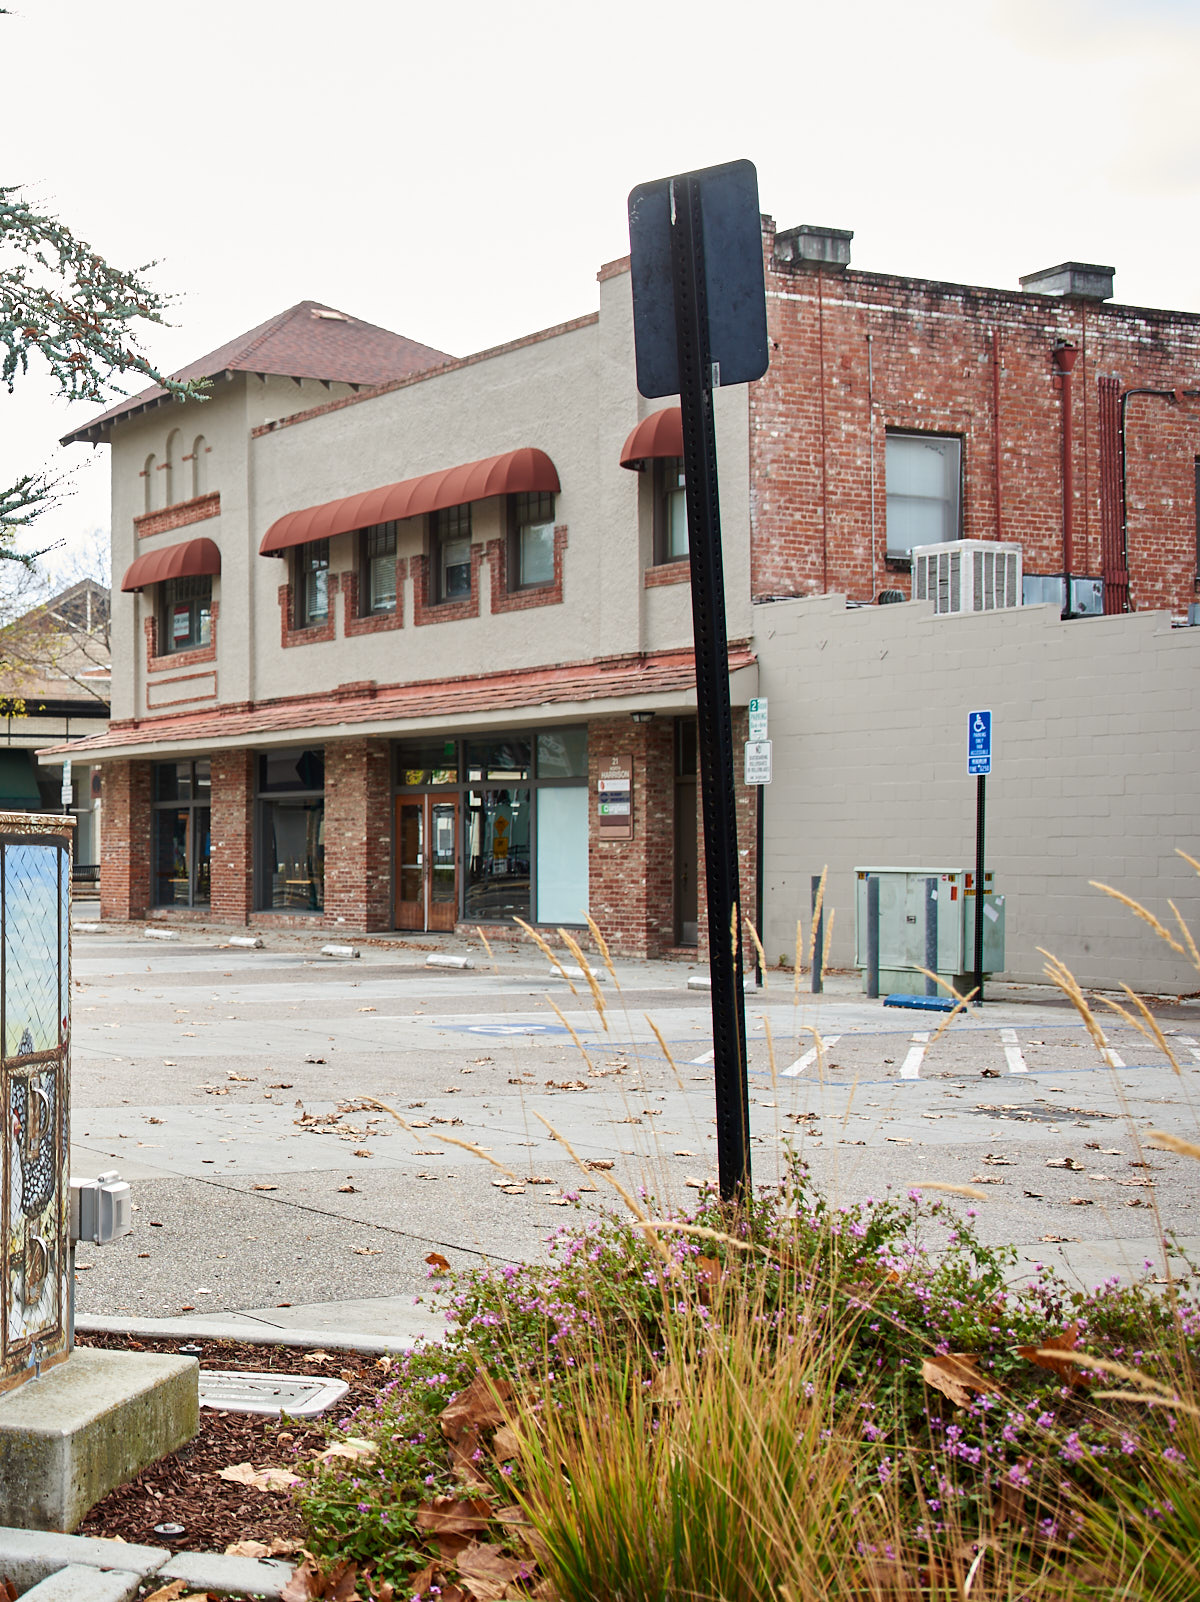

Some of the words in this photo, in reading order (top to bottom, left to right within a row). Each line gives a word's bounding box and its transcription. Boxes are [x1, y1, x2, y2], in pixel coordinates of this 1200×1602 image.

[751, 700, 757, 710] 2
[612, 757, 619, 765] 21
[601, 770, 630, 779] HARRISON
